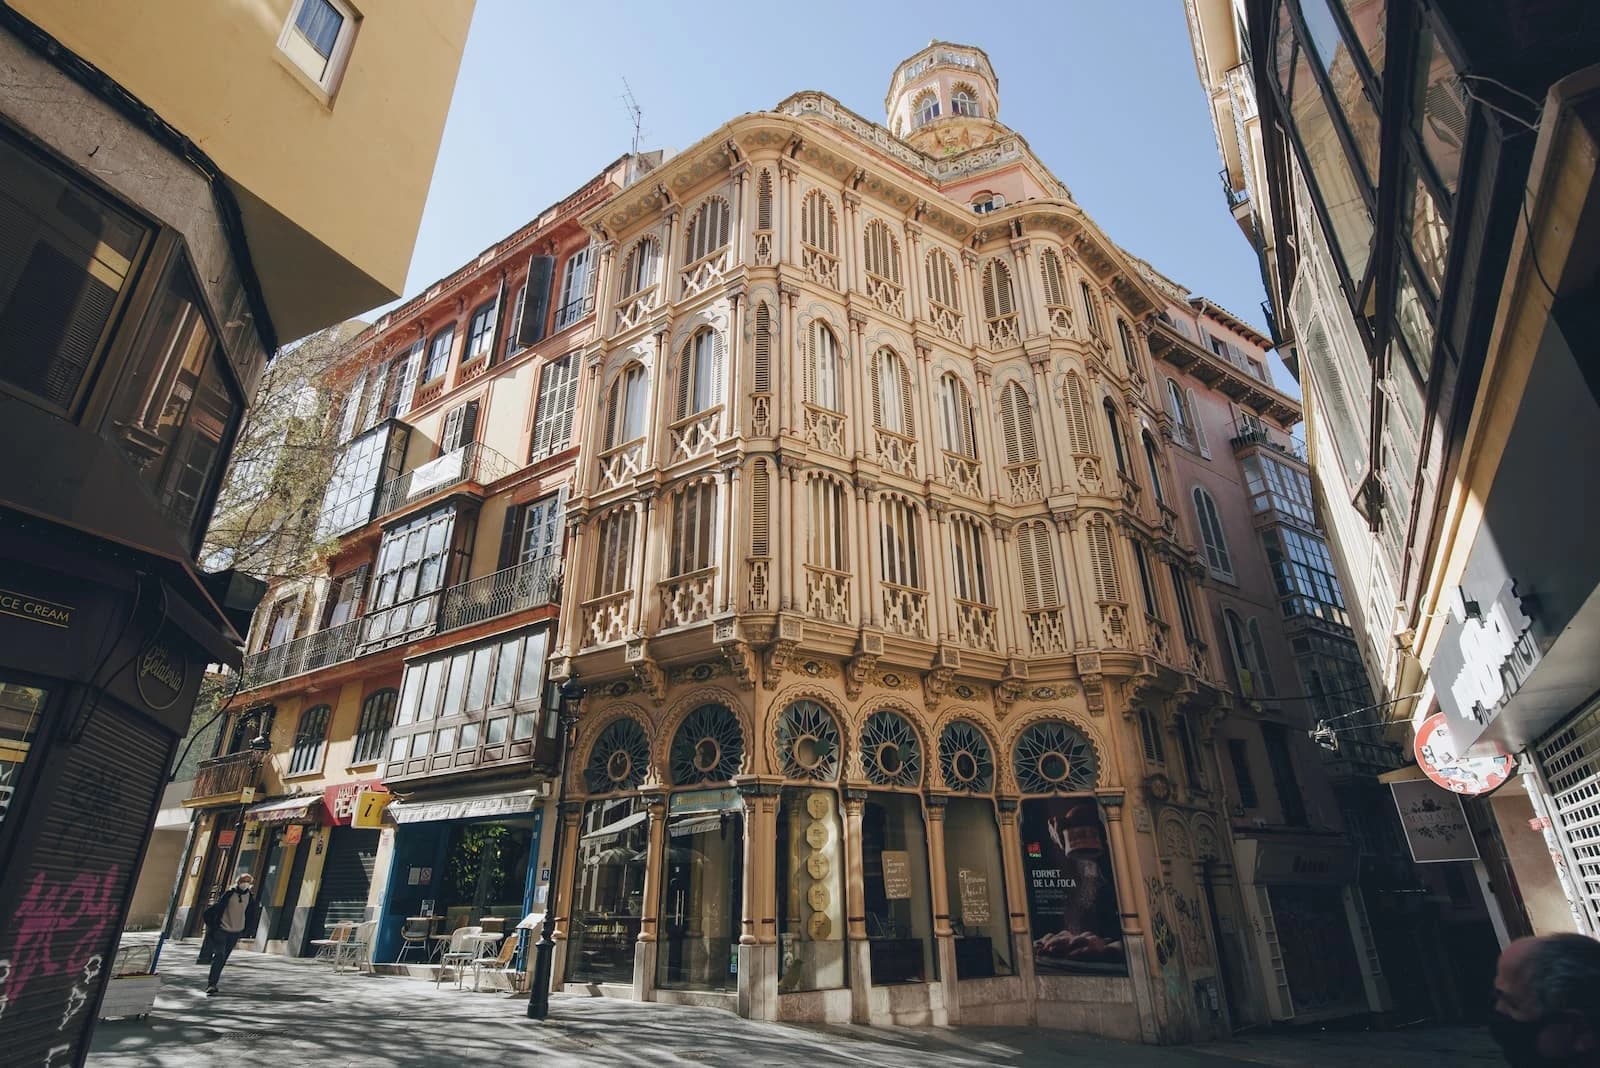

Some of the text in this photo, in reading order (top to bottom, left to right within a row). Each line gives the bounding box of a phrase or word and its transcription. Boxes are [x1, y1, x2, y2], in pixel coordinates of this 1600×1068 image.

[0, 596, 70, 622] CE CREAM
[333, 798, 354, 818] PEA
[1032, 869, 1061, 878] FORNET
[1033, 879, 1044, 888] DE
[1044, 879, 1055, 888] LA
